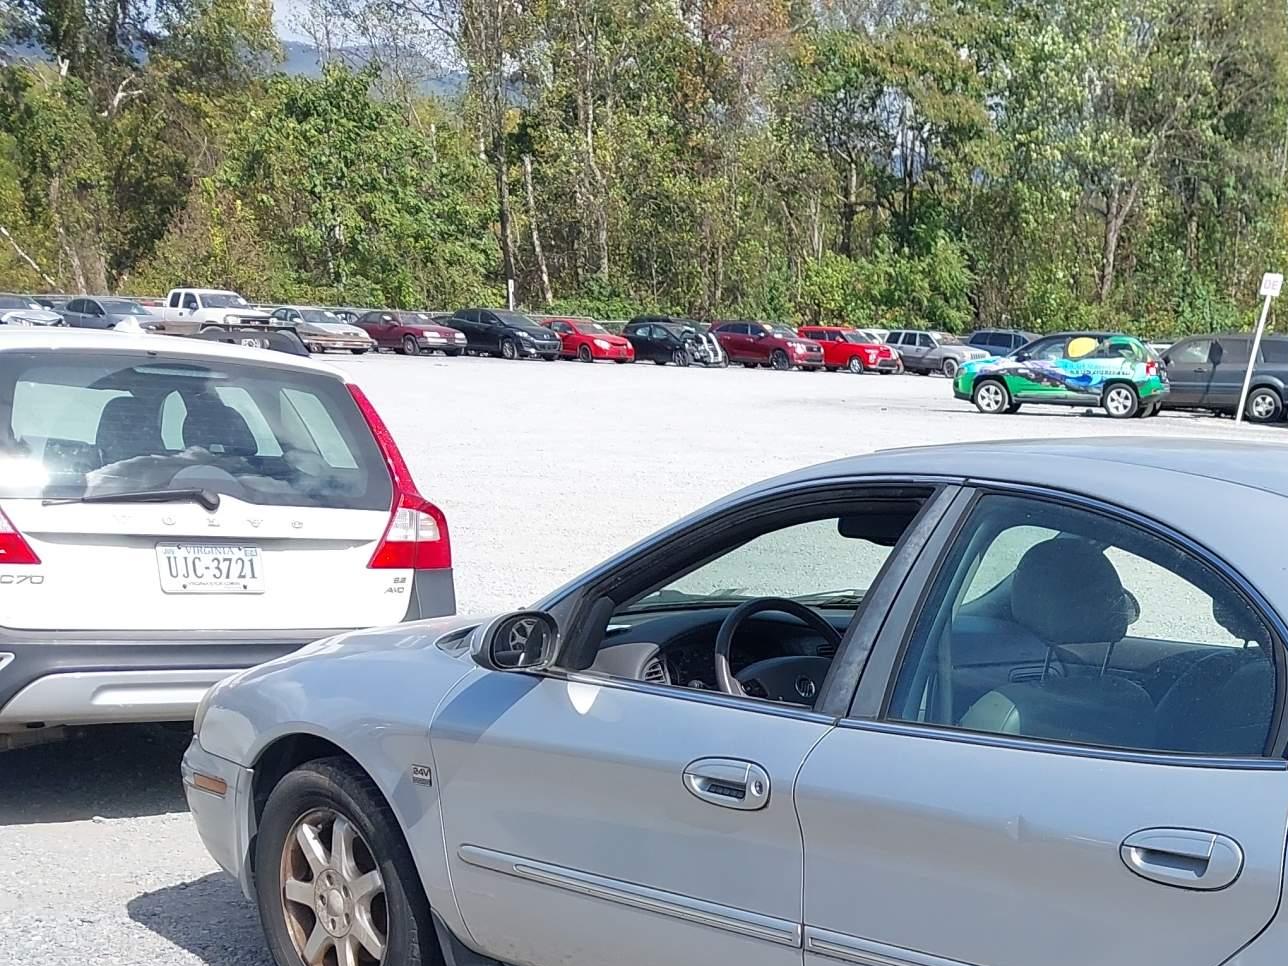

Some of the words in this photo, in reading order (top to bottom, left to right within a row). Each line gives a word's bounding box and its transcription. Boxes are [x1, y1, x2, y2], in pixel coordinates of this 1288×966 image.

[185, 544, 235, 556] VIRGINIA
[166, 555, 258, 580] UJC-3721
[412, 767, 430, 777] 24V
